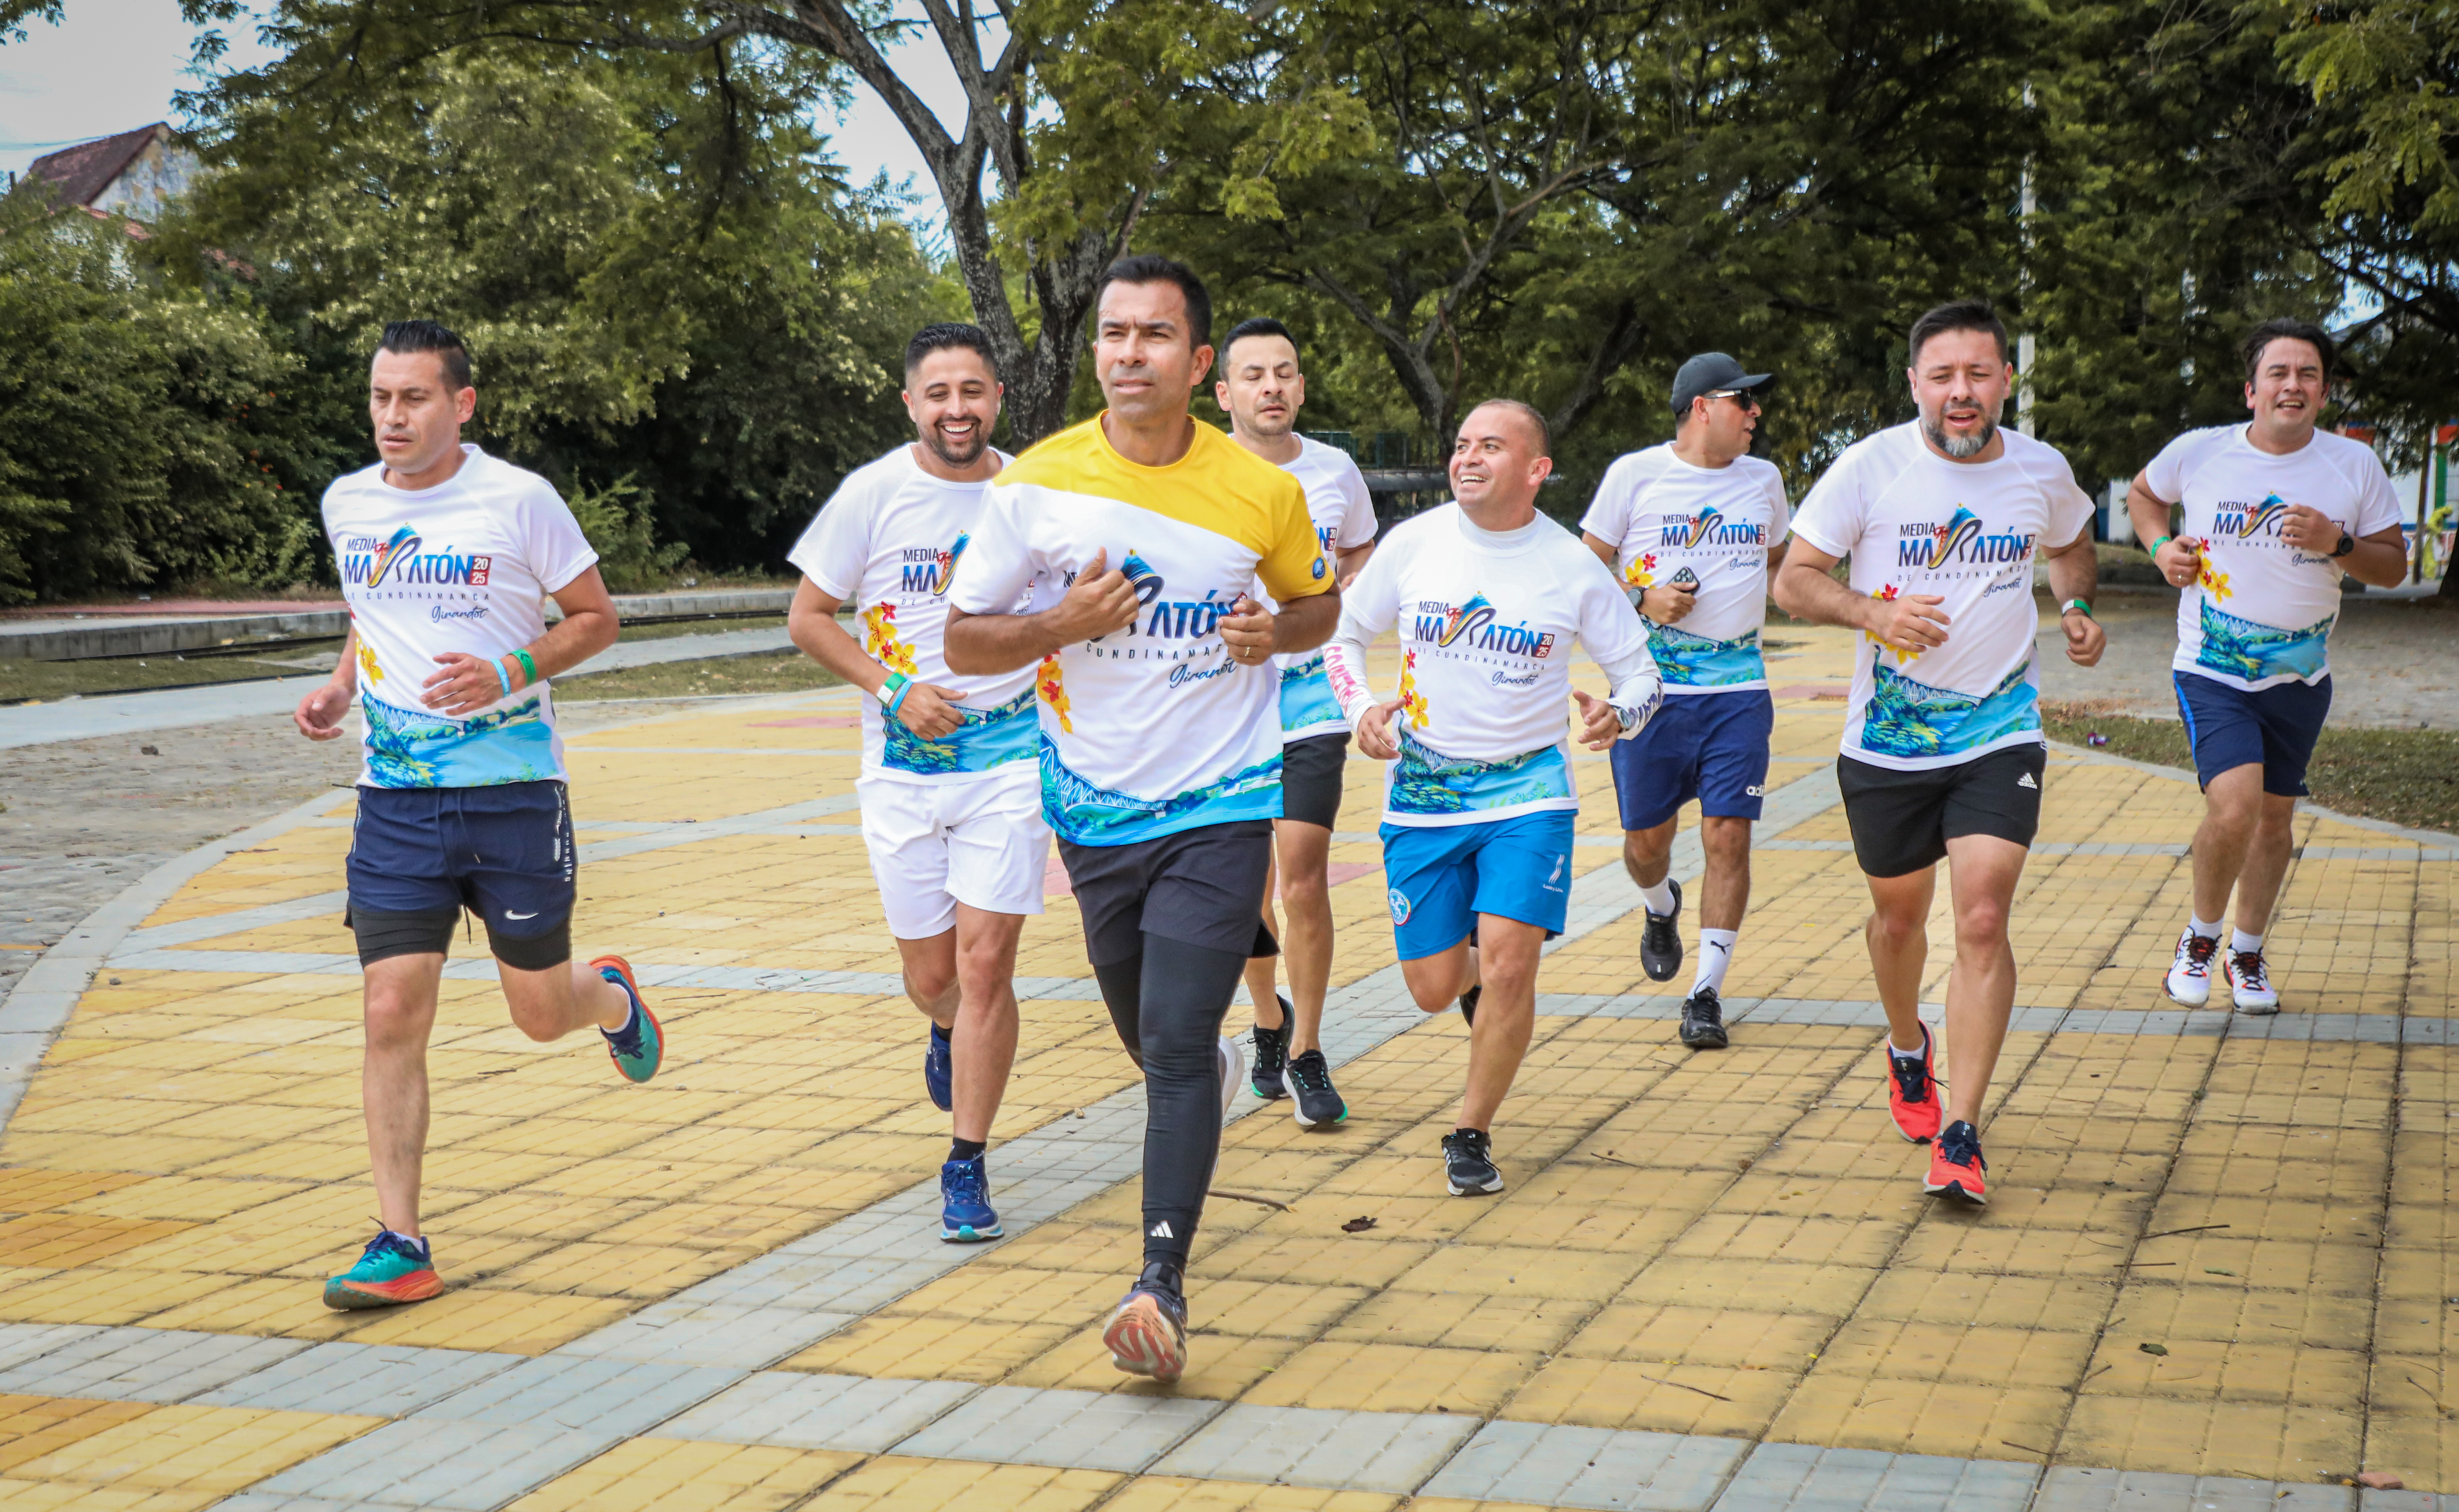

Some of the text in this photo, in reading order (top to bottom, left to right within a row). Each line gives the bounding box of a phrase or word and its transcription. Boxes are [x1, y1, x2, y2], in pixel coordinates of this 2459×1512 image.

[2217, 501, 2248, 512] MEDIA
[1663, 514, 1690, 525] MEDIA
[1330, 528, 1336, 539] 20
[1661, 514, 1759, 549] MARATÓN
[1900, 522, 1936, 537] MEDIA
[347, 538, 377, 552] MEDIA
[1898, 520, 2028, 570] MARATÓN
[903, 548, 939, 563] MEDIA
[344, 537, 489, 589] MARATÓN 20
[471, 572, 487, 585] 25
[367, 591, 490, 601] CUNDINAMARCA
[1417, 601, 1449, 614] MEDIA
[1415, 608, 1553, 658] MARATÓN 20
[1536, 647, 1549, 657] 25
[1436, 651, 1545, 671] CUNDINAMARCA
[2017, 781, 2038, 789] adidas
